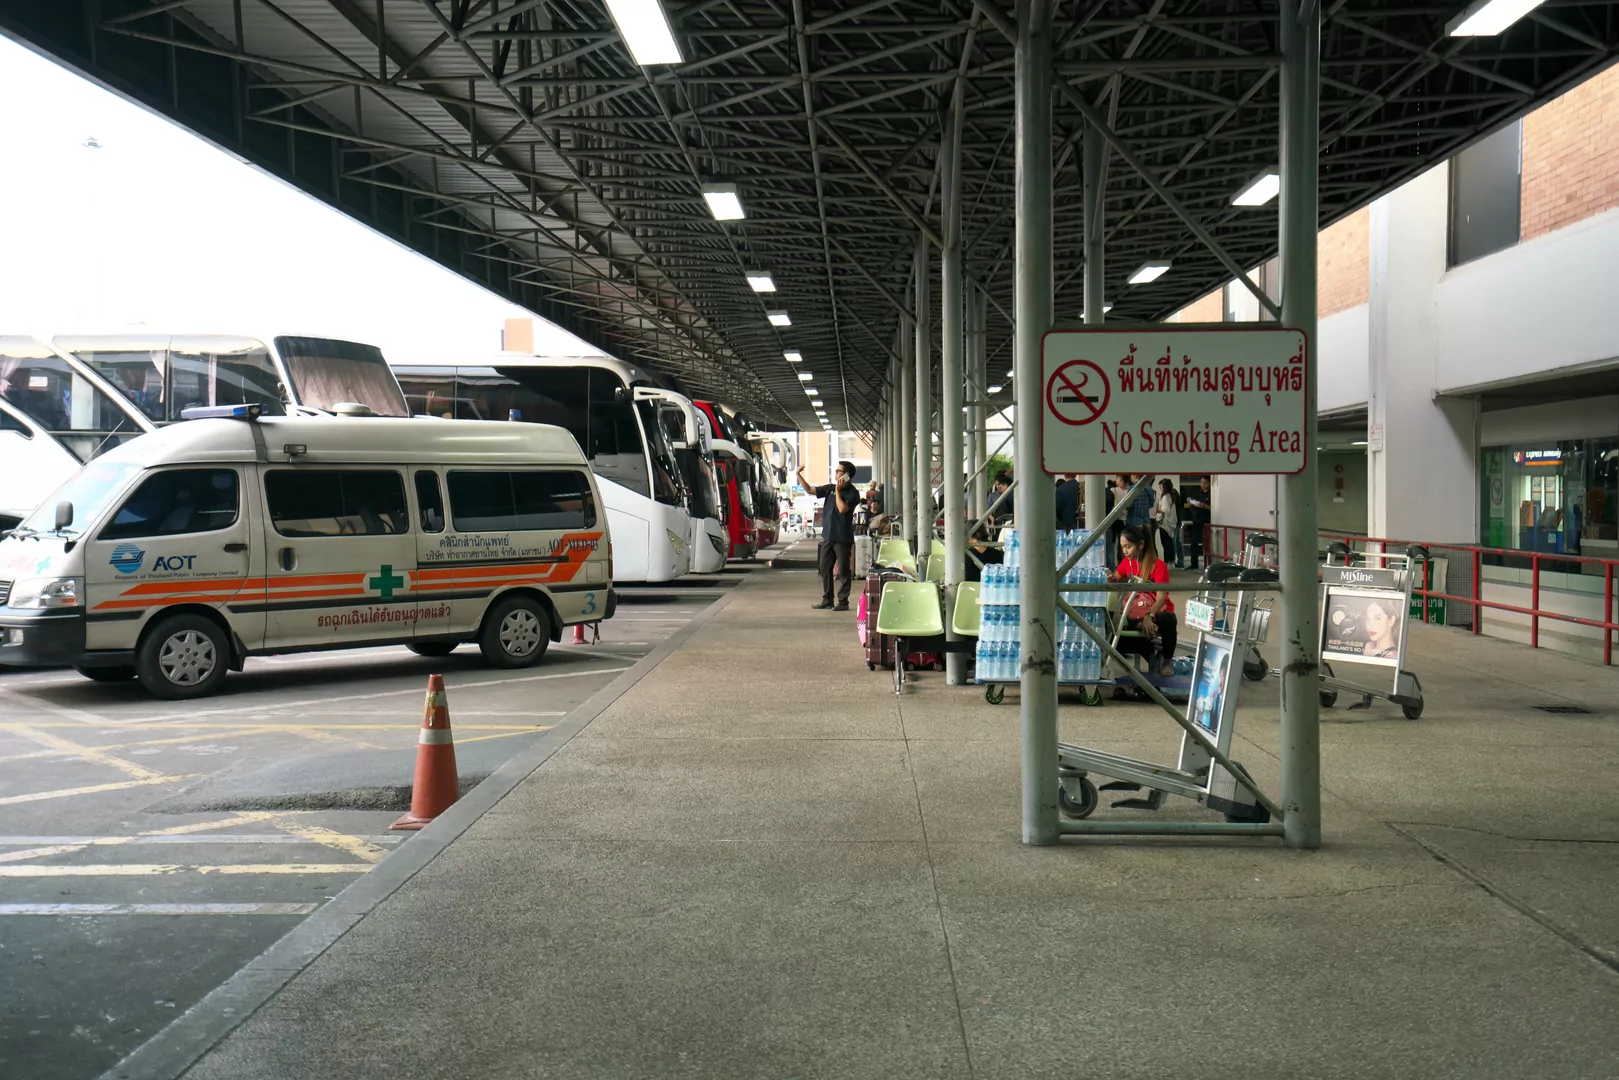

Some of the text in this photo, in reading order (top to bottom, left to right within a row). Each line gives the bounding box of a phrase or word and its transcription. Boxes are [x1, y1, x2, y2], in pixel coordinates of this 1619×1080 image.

[1117, 343, 1303, 407] พื้นที่ห้ามสูบบุหรี่
[1100, 419, 1302, 465] No Smoking Area
[439, 533, 510, 549] คลินิกสำนักแพทย์
[152, 555, 198, 572] AOT
[425, 549, 445, 560] บริษัท
[446, 546, 499, 559] ท่าอากาศยานไทย
[580, 592, 596, 615] 3
[317, 602, 451, 631] รถฉุกเฉินได้รับอนุญาตแล้ว
